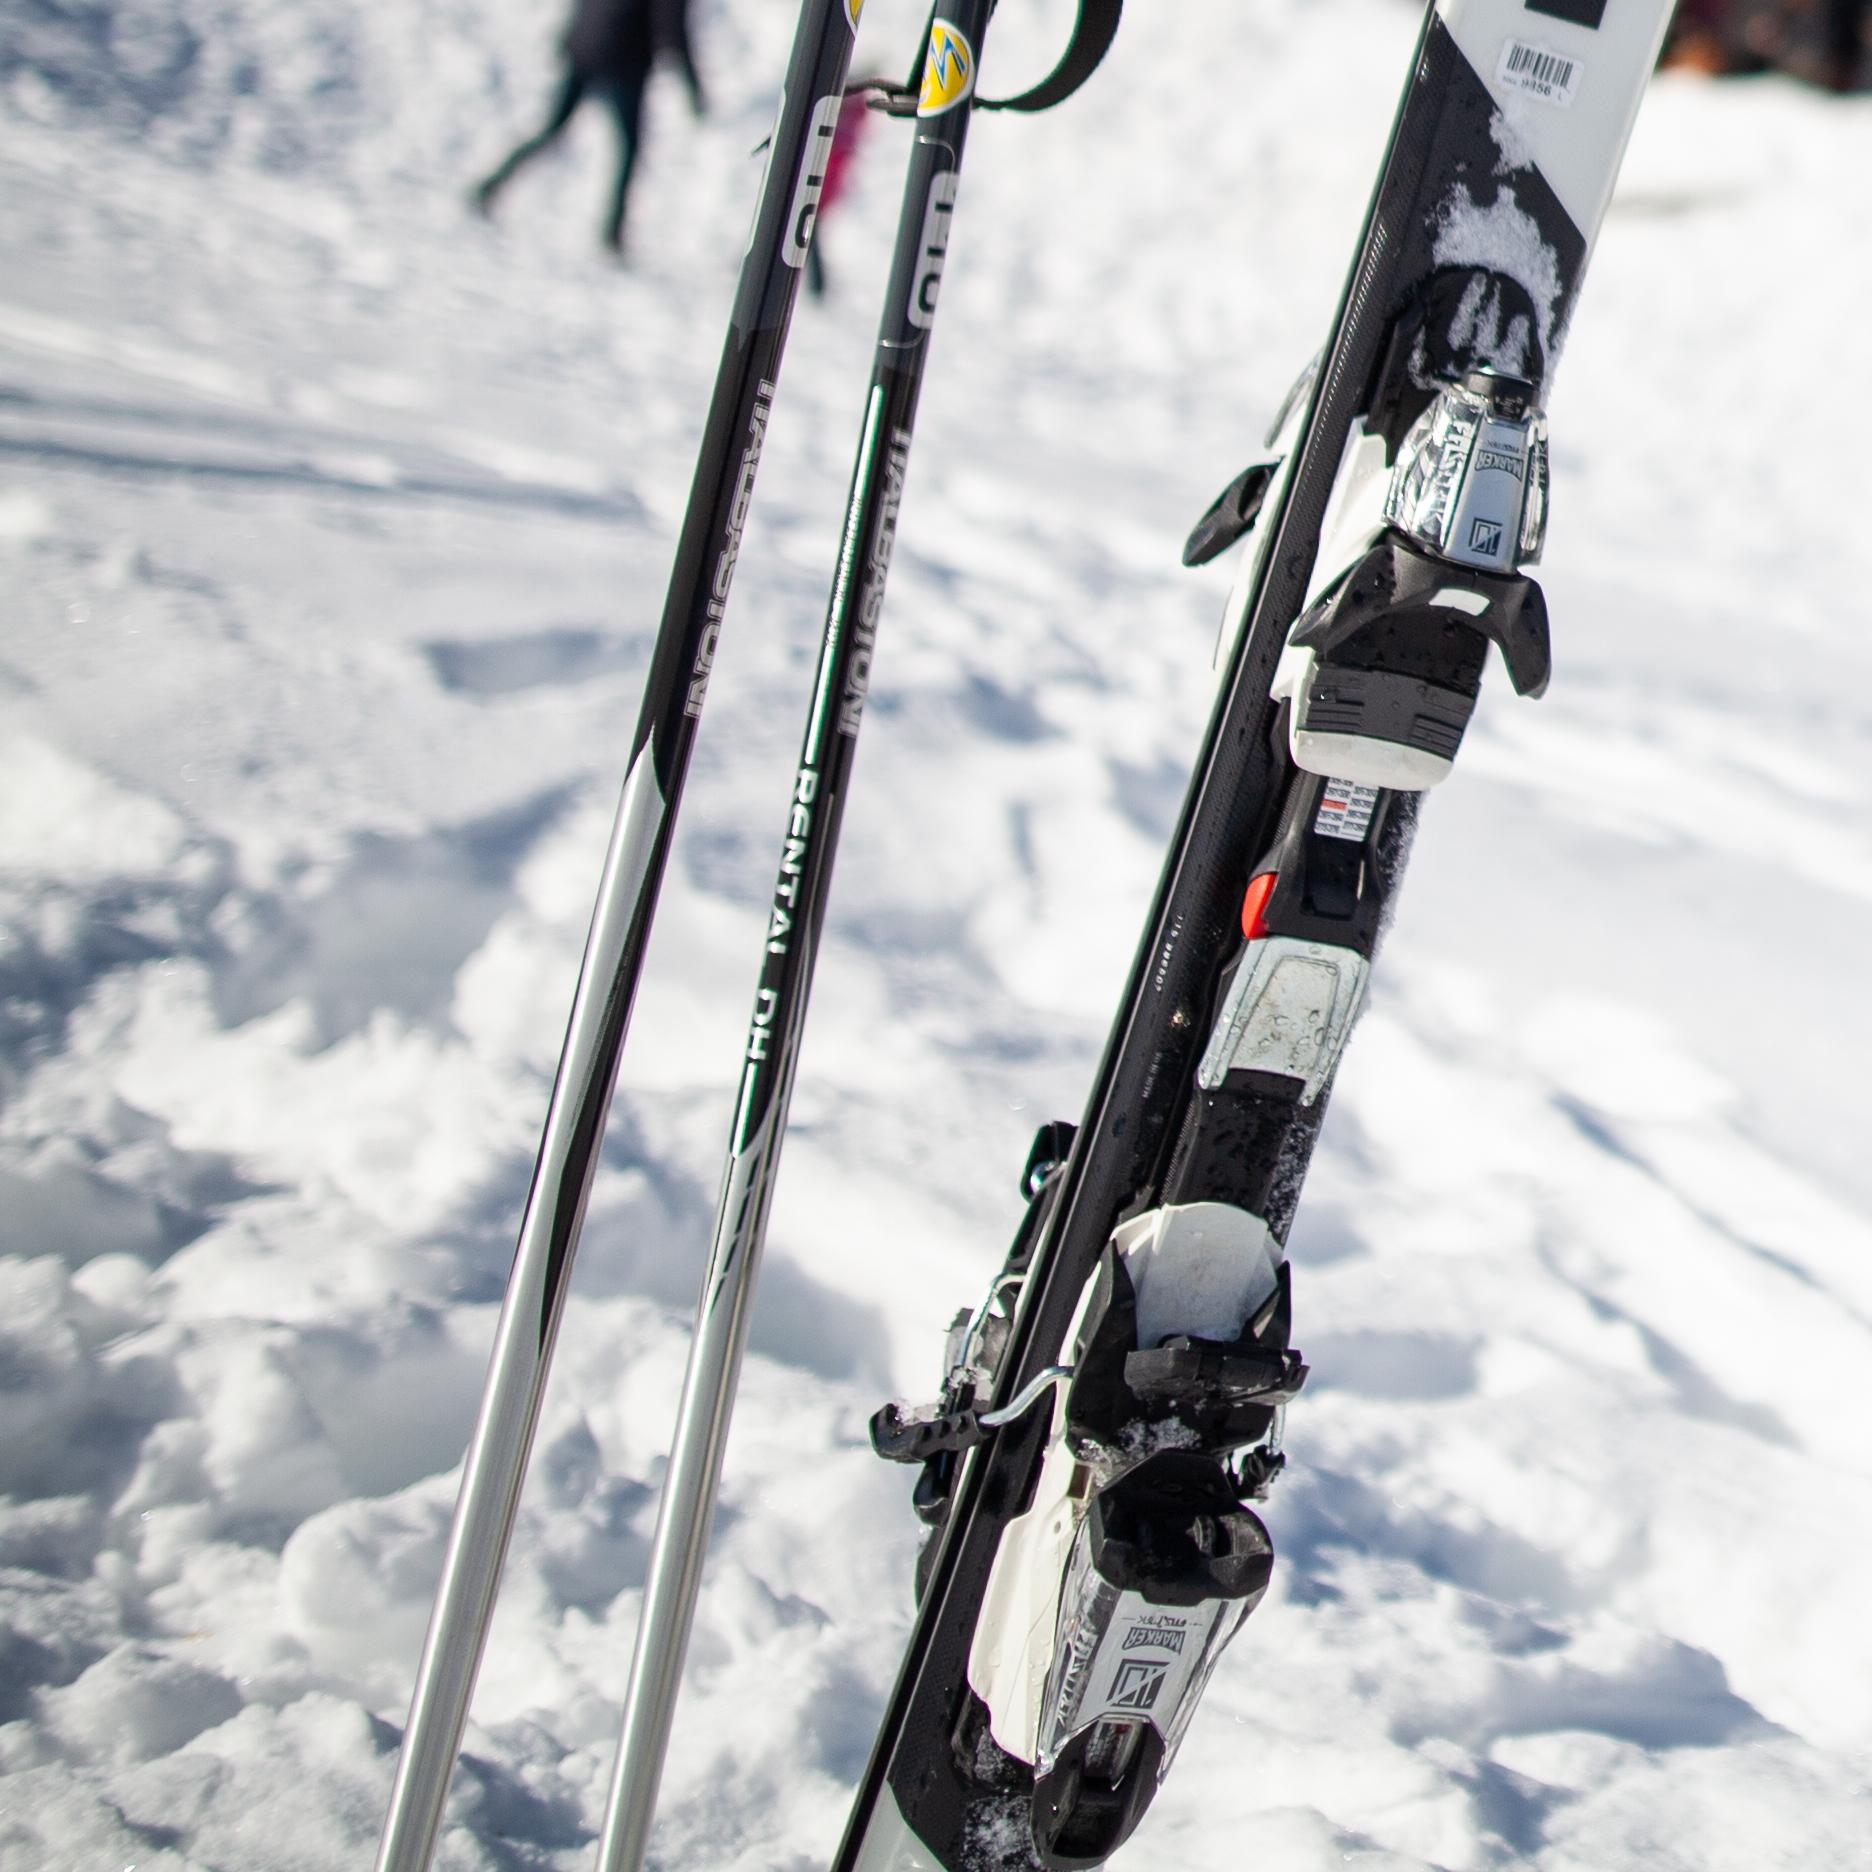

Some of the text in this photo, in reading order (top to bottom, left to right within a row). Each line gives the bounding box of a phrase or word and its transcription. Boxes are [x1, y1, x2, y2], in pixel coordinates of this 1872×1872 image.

[1475, 450, 1525, 481] MARKER
[744, 770, 818, 1060] RENTAL DH
[1122, 1625, 1186, 1656] MARKER
